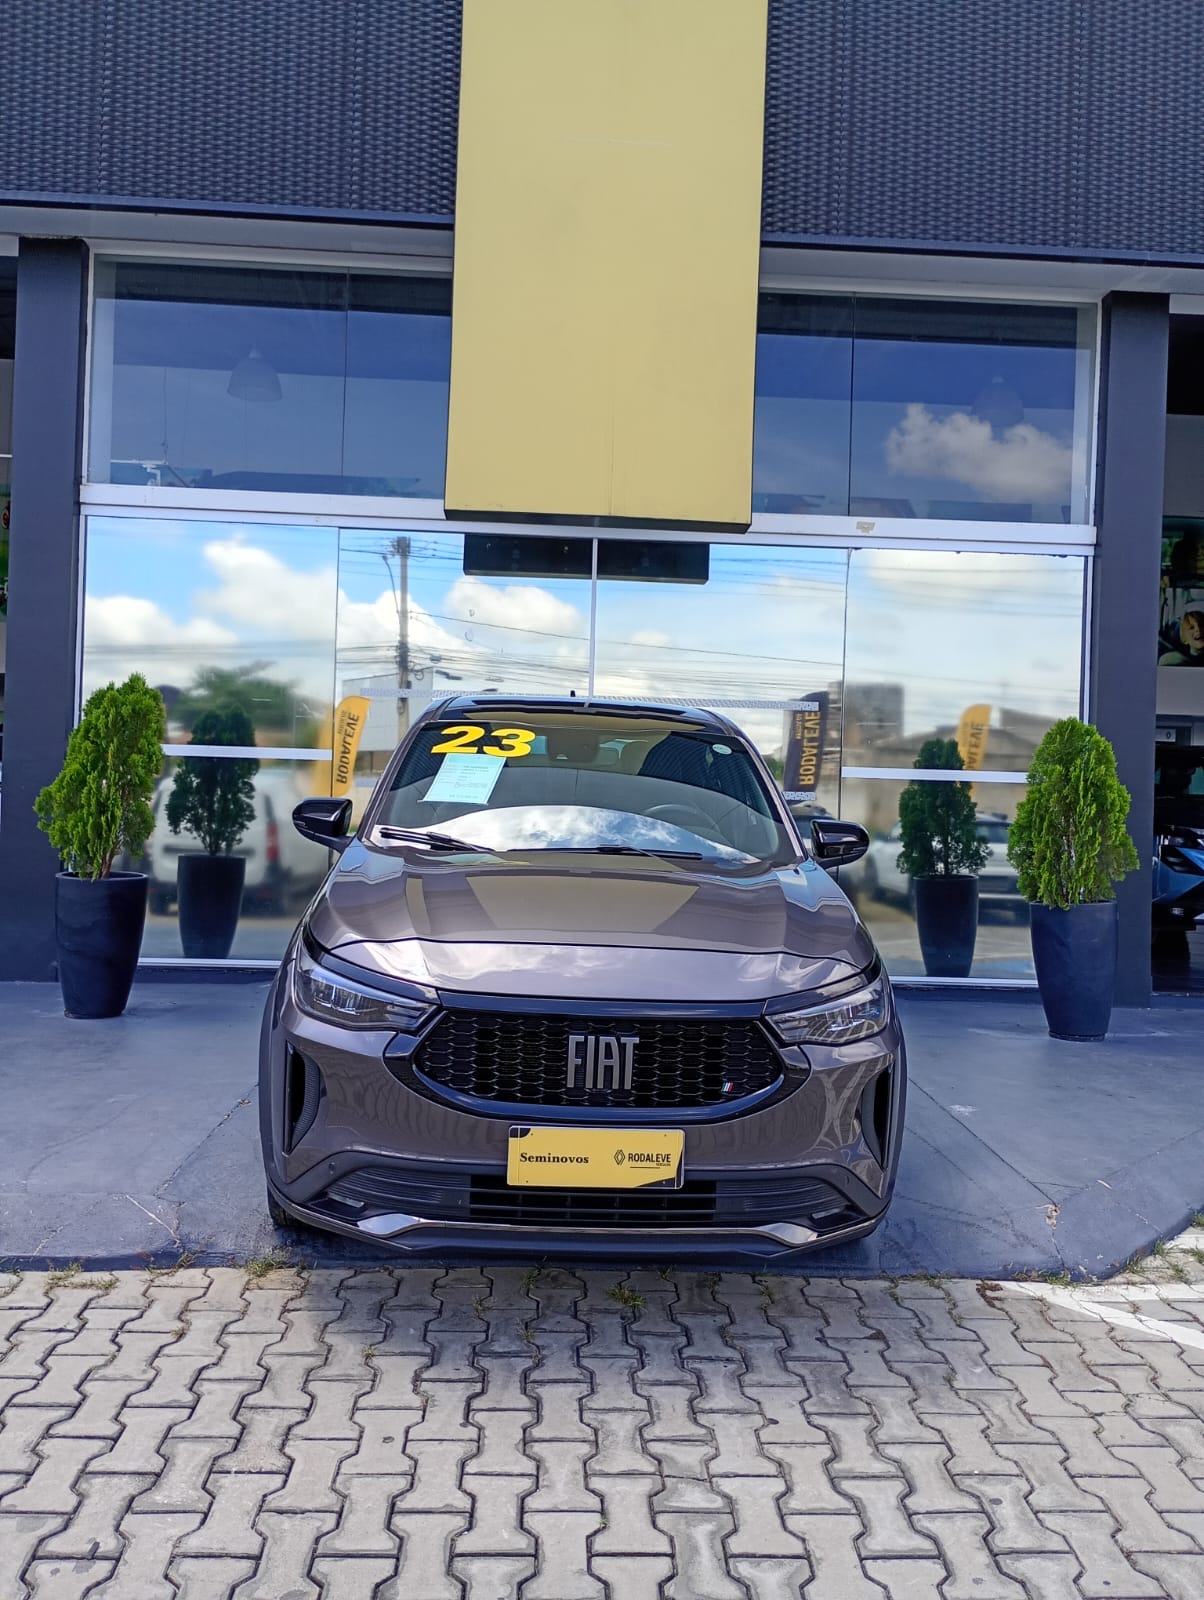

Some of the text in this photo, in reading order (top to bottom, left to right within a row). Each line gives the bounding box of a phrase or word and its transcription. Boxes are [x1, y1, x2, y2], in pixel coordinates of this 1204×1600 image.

[430, 725, 537, 758] 23
[566, 1034, 640, 1090] FIAT
[519, 1152, 589, 1164] Seminovos
[628, 1152, 672, 1163] RODALEVE
